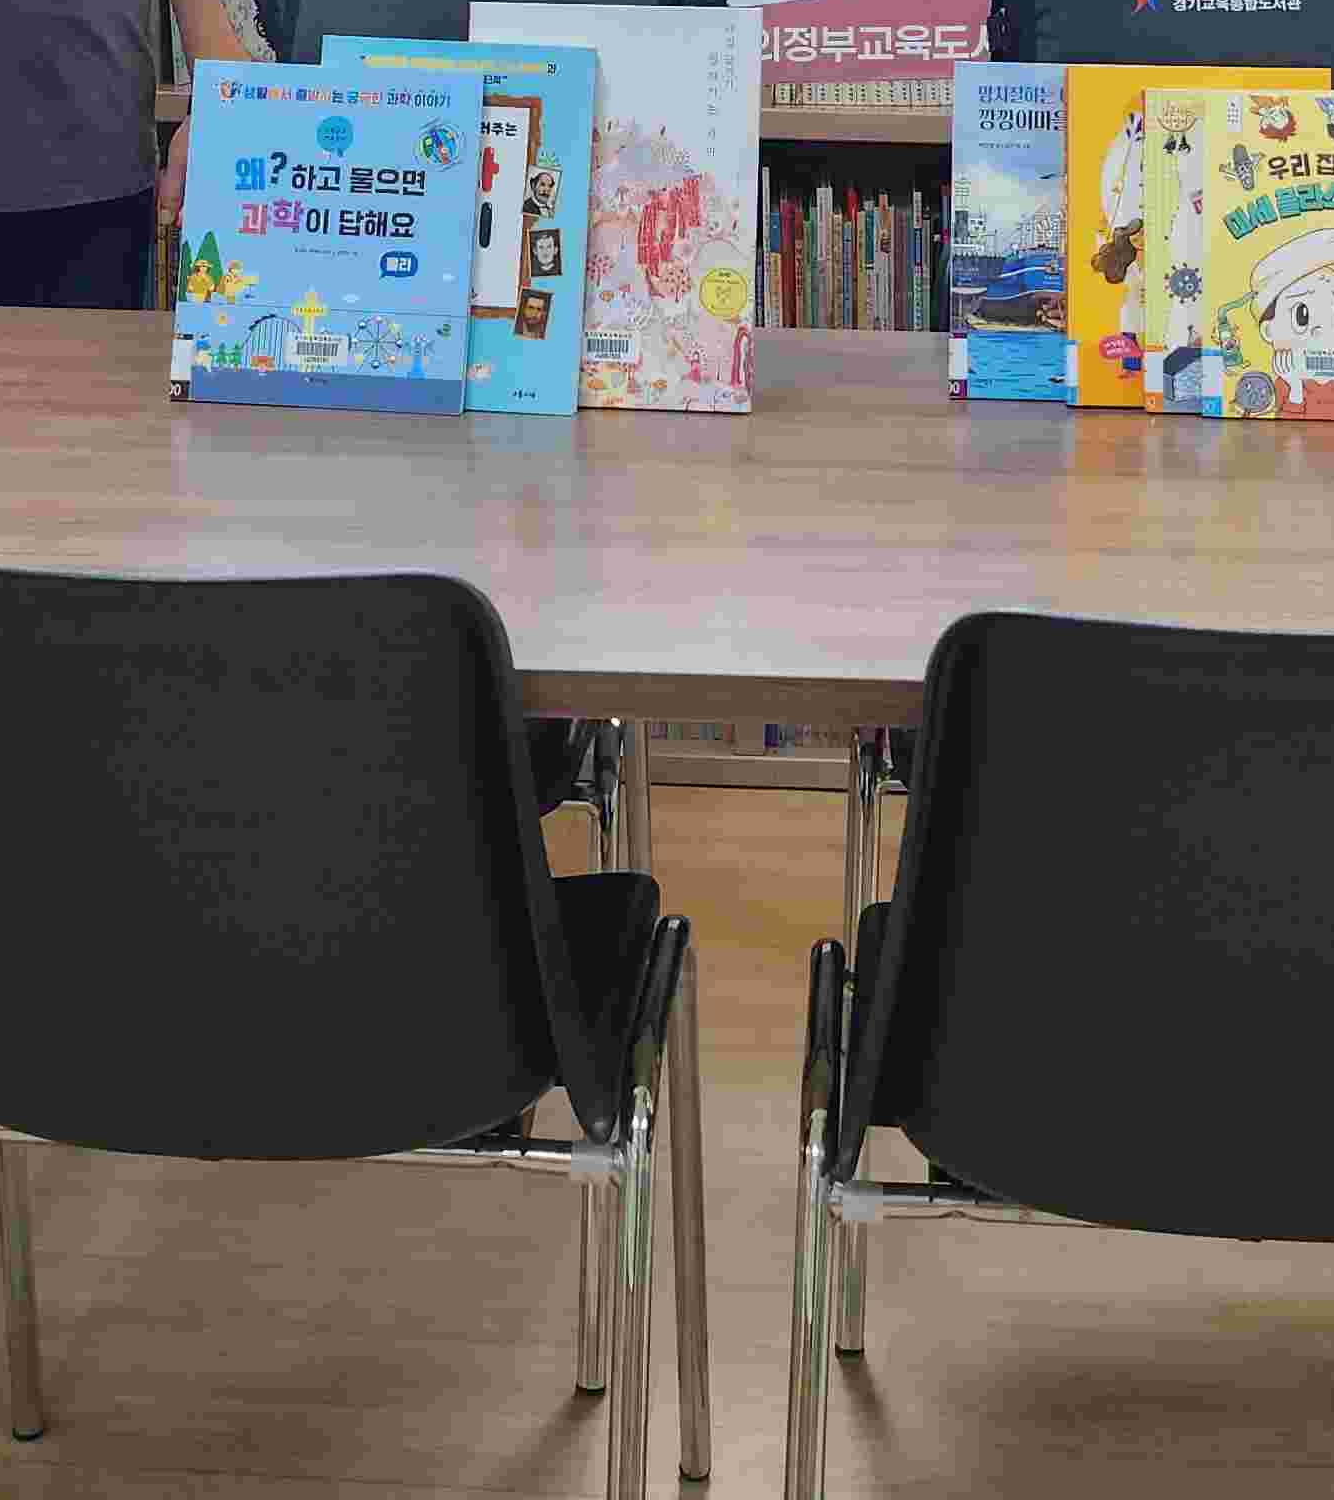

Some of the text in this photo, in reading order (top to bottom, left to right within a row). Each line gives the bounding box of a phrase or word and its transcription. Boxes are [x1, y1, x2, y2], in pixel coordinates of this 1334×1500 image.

[1268, 153, 1310, 180] 우리
[350, 167, 425, 196] 물으면
[239, 198, 414, 238] 과학이 답해요
